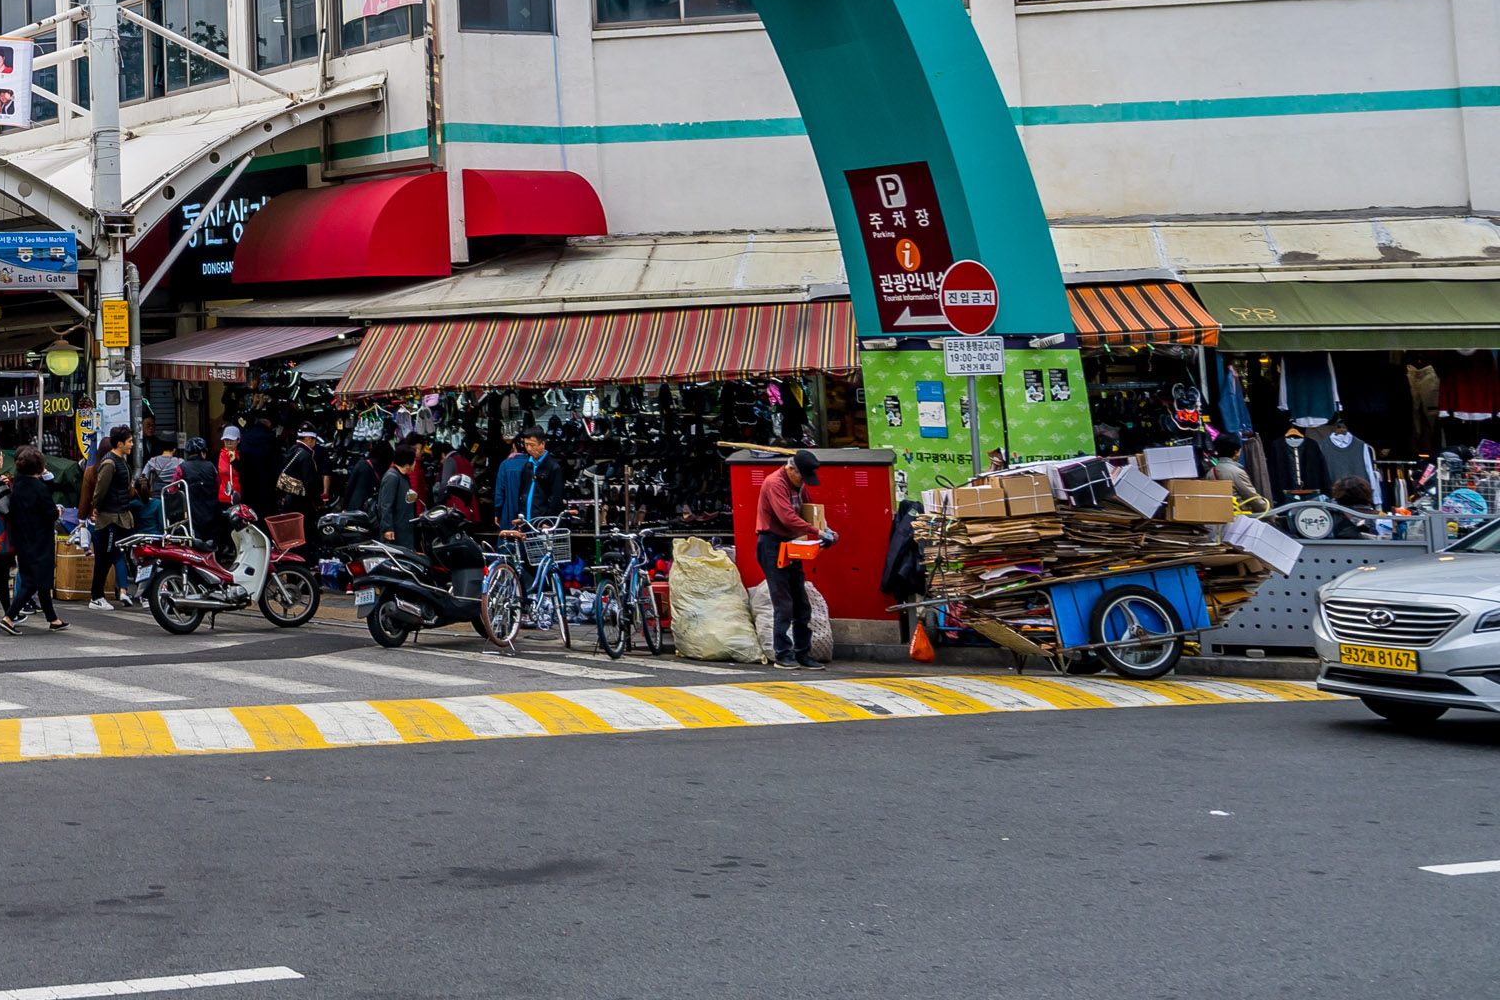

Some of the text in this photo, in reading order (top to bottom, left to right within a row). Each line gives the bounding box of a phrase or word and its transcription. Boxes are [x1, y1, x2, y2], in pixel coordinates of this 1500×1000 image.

[869, 208, 930, 230] 주차장
[0, 236, 24, 244] 서문시장
[18, 274, 67, 283] East 1 Gate
[883, 294, 902, 302] Tourist
[903, 293, 934, 301] Information
[947, 292, 993, 304] 진입금지
[950, 352, 999, 362] 19:00~00:30
[43, 397, 70, 415] 2,000
[915, 451, 973, 466] 대구광역시 중구
[1378, 650, 1411, 668] 8167
